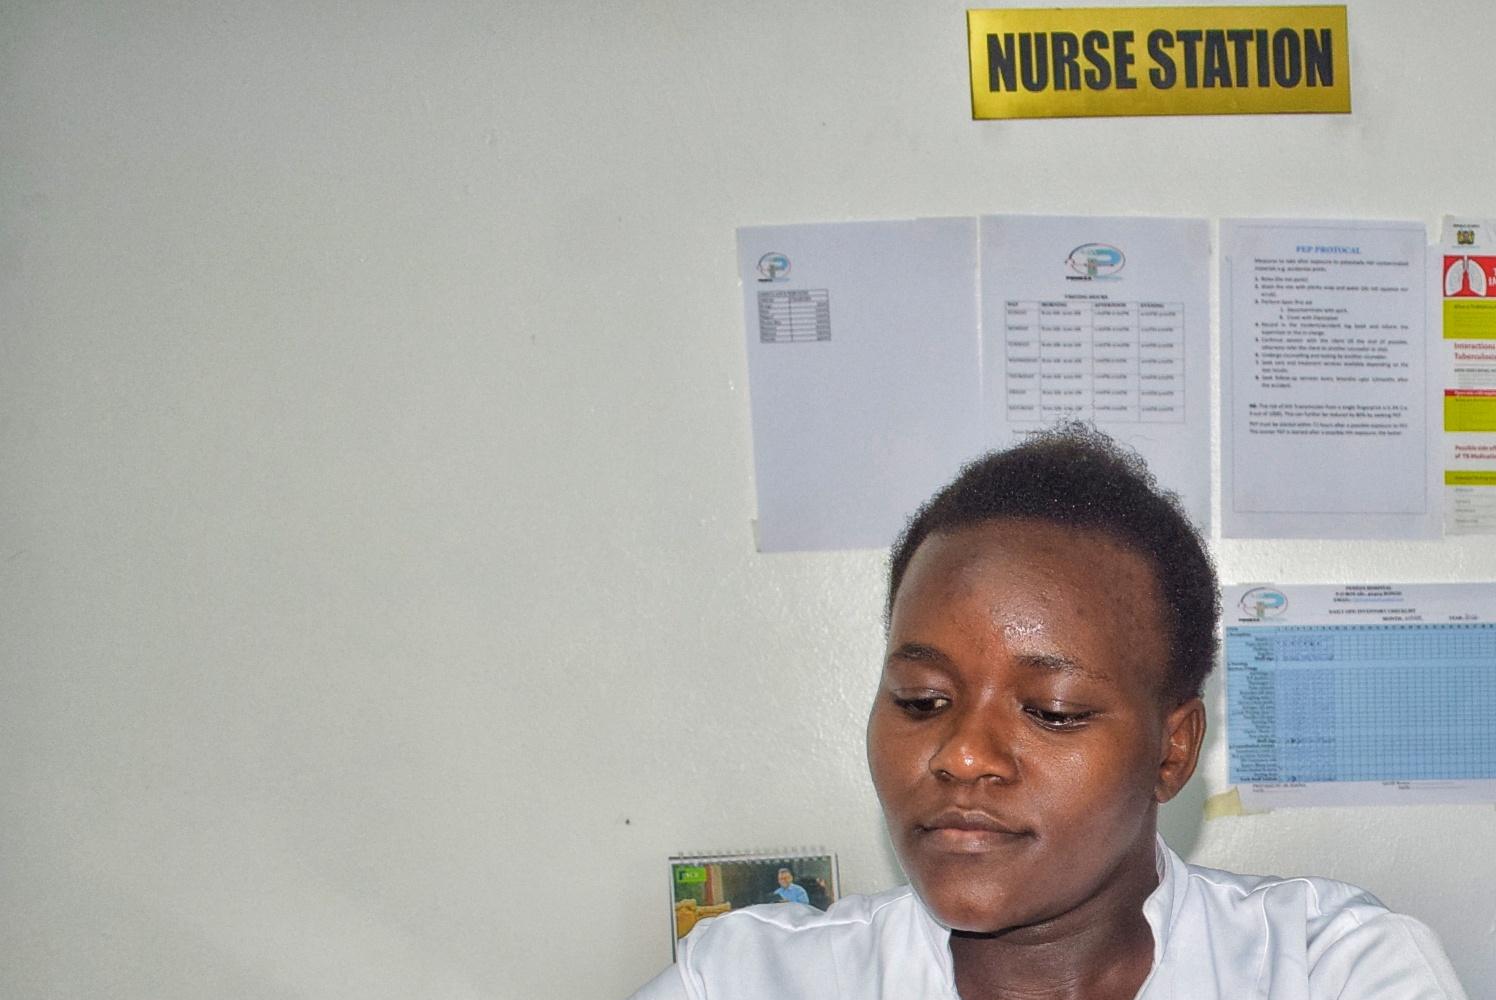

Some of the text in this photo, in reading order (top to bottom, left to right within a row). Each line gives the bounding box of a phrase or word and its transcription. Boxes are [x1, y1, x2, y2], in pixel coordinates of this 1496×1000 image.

[986, 27, 1333, 93] NURSE STATION
[1454, 342, 1496, 350] Interactions
